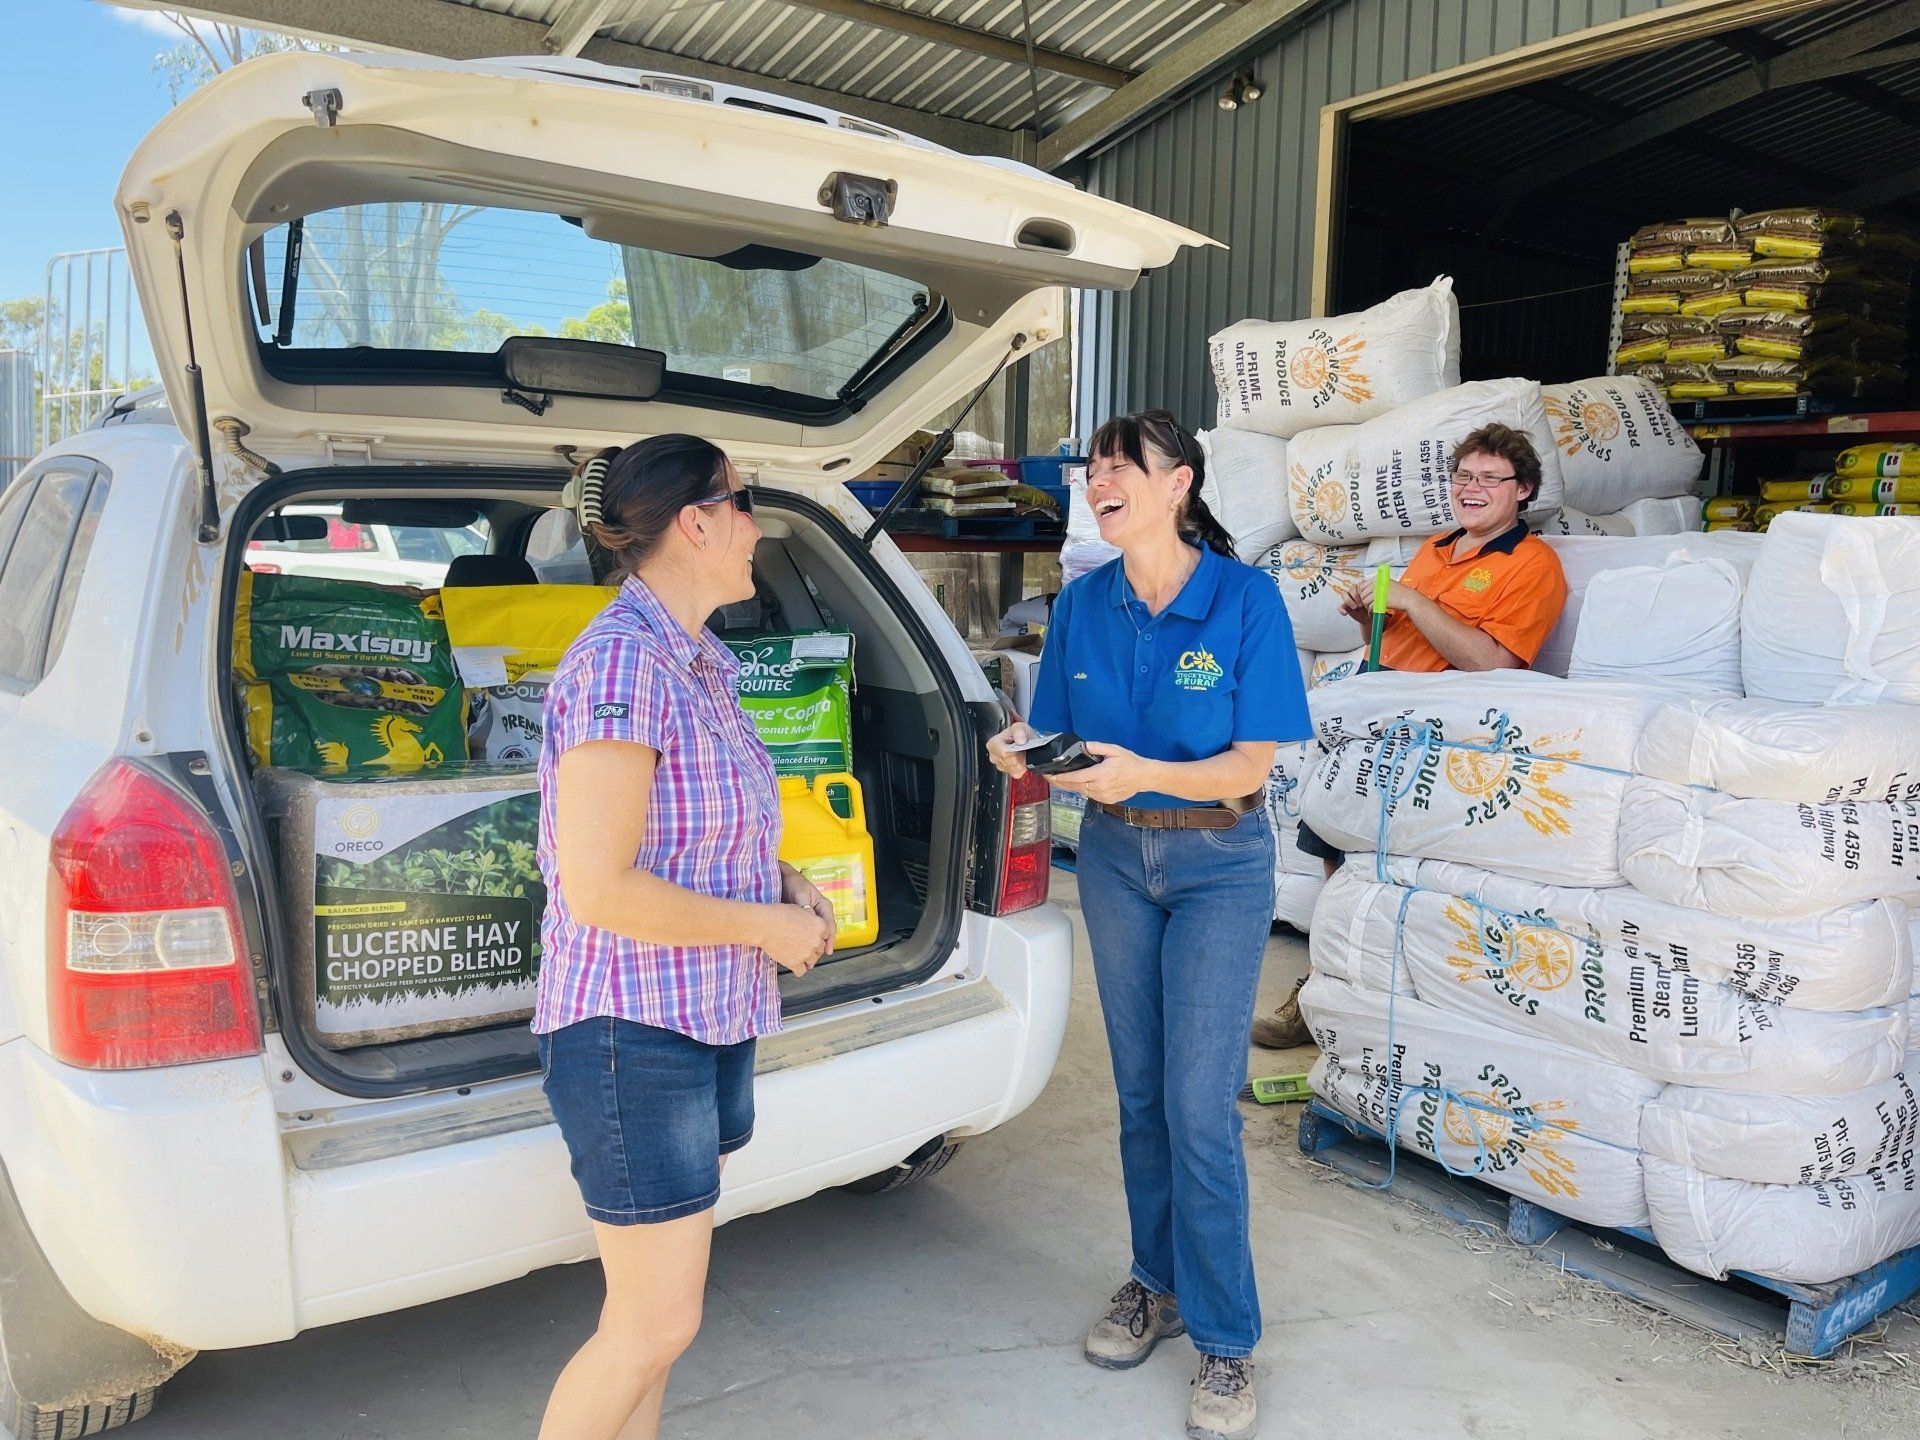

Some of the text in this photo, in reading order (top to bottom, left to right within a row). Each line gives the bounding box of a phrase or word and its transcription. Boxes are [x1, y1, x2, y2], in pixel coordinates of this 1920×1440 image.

[1236, 342, 1250, 414] OATEN CHAFF
[1247, 352, 1262, 401] PRIME
[1275, 340, 1291, 406] PRODUCE
[1308, 329, 1339, 409] SPRENGER'S
[1568, 389, 1612, 462] SPRENGER'S
[1605, 388, 1641, 449] PRODUCE
[1635, 391, 1662, 437] PRIME
[1658, 413, 1675, 446] OATEN
[1420, 440, 1430, 463] 4356
[1436, 440, 1444, 472] Highway
[1306, 460, 1345, 541] SPRENGER'S
[1350, 462, 1368, 531] PRODUCE
[1376, 464, 1393, 520] PRIME
[1391, 449, 1412, 528] OATEN CHAFF
[279, 625, 432, 663] Maxisoy
[783, 700, 831, 721] Copra
[791, 720, 816, 735] Meal
[773, 756, 828, 764] alanced Energy
[1356, 759, 1374, 798] Chaff
[1797, 803, 1816, 829] 4306
[1818, 809, 1836, 861] Highway
[335, 841, 384, 852] ORECO
[1844, 829, 1860, 871] 4356
[328, 904, 395, 914] BALANCED BLEND
[328, 922, 366, 930] PRECISION
[419, 918, 434, 926] DAY
[435, 916, 465, 925] HARVEST
[476, 913, 492, 921] BALE
[326, 920, 521, 958] LUCERNE HAY
[1669, 943, 1690, 972] haff
[326, 947, 522, 982] CHOPPED BLEND
[329, 983, 362, 991] PERFECTLY
[464, 971, 495, 979] FORAGING
[496, 968, 522, 976] ANIMALS
[1627, 966, 1648, 1044] Premium
[1893, 1072, 1919, 1146] Premium
[1815, 1133, 1832, 1163] 2075
[1832, 1116, 1849, 1147] Ph:
